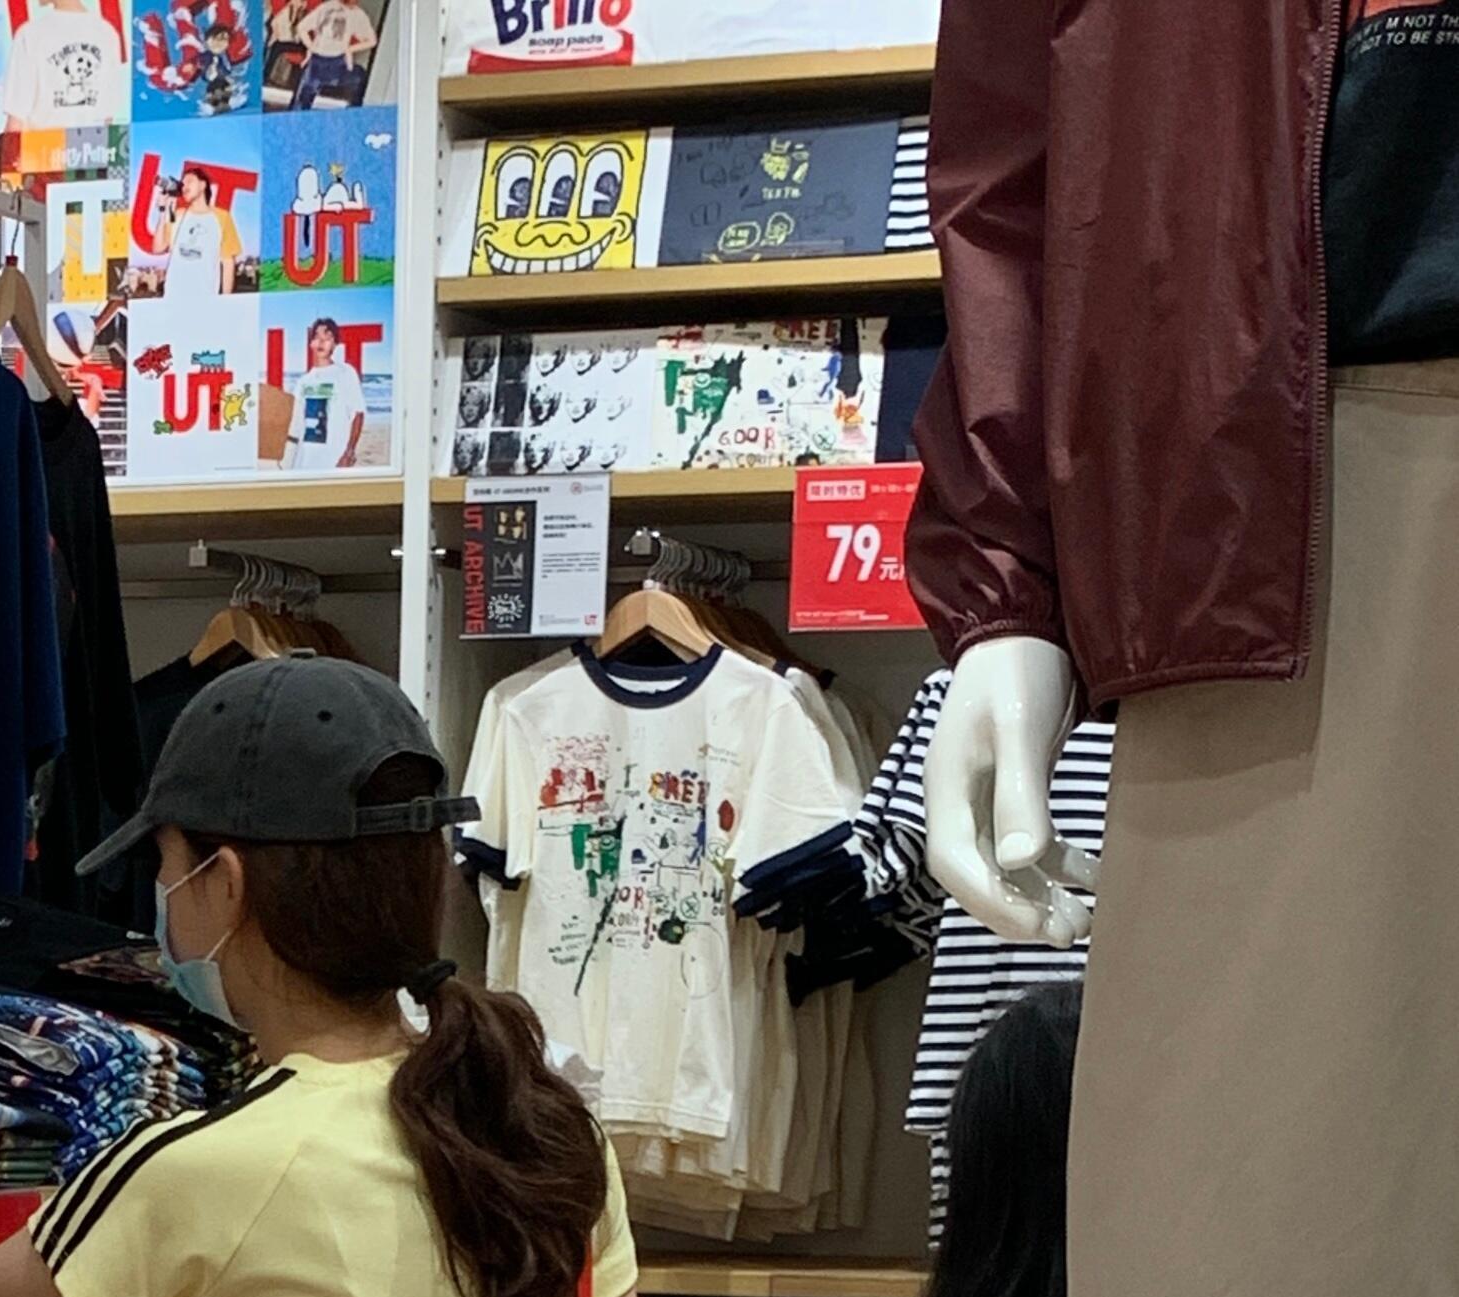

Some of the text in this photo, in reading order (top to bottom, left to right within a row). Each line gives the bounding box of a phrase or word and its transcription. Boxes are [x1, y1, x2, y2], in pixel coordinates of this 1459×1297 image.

[1387, 32, 1407, 45] TO
[1410, 31, 1431, 44] BE
[1404, 15, 1436, 28] NOT
[1442, 14, 1459, 28] TH
[283, 208, 374, 287] UT
[163, 372, 234, 433] UT
[463, 506, 486, 634] UT ARCHIVE
[826, 523, 882, 583] 79
